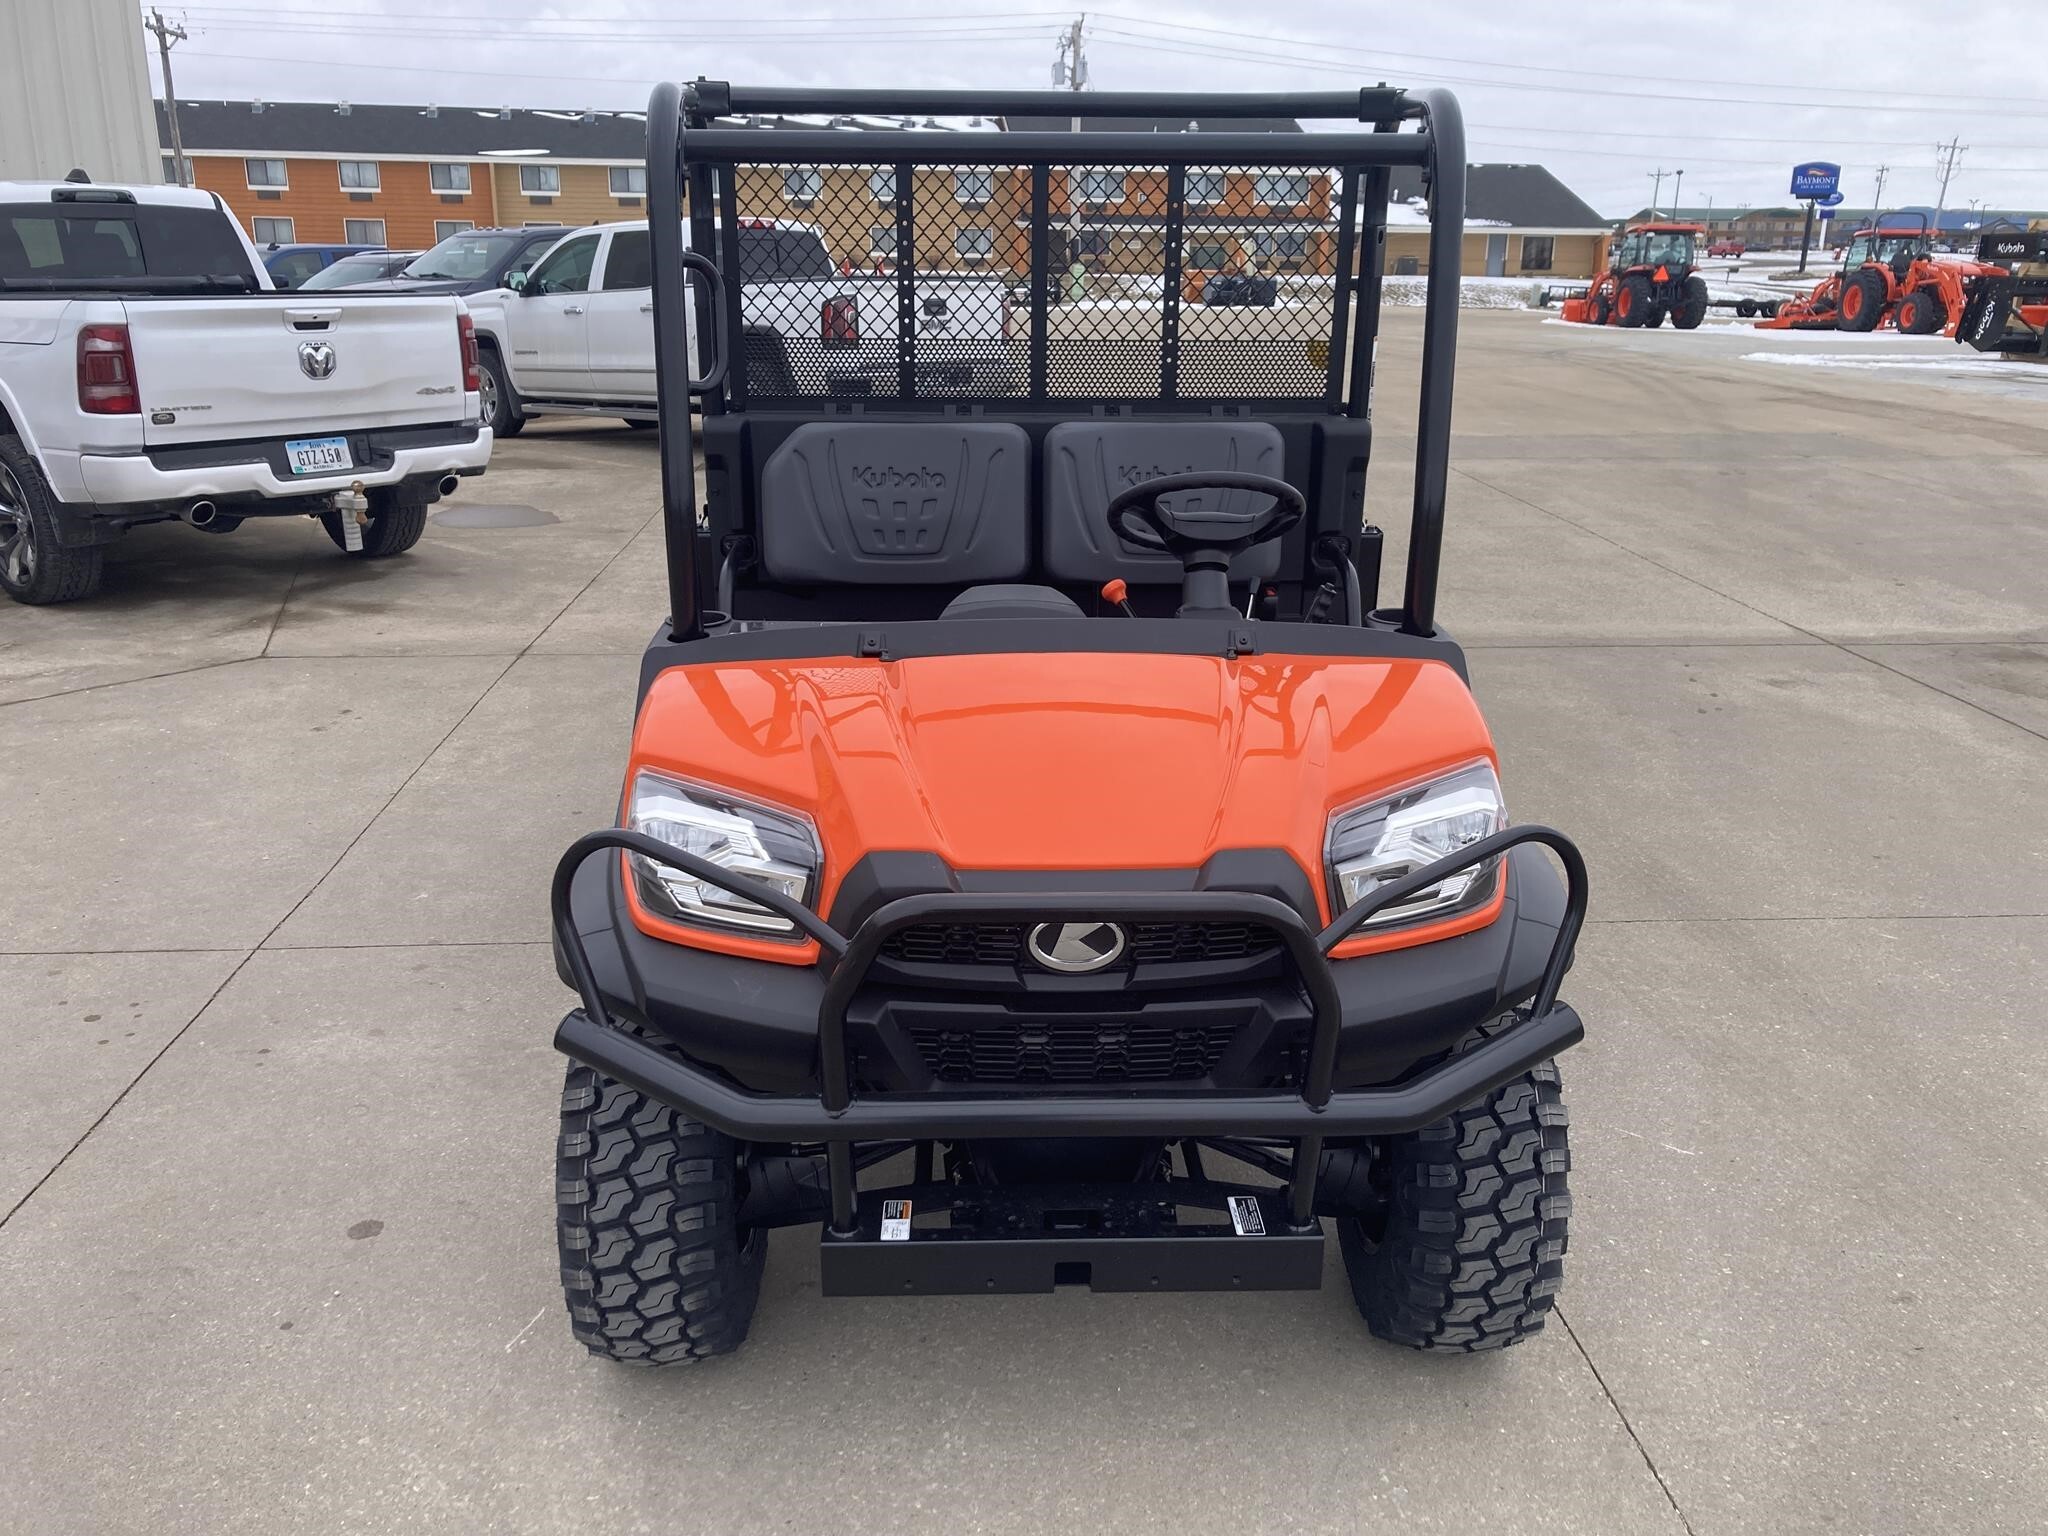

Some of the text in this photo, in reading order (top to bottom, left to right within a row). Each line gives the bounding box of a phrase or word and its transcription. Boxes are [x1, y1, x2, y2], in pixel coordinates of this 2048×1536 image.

[1797, 176, 1837, 184] BAYMONT
[1998, 242, 2025, 253] Kubota
[920, 319, 952, 330] GMC
[1975, 301, 1996, 340] Kubota
[297, 447, 342, 466] GTZ 150
[852, 465, 946, 488] Kubota
